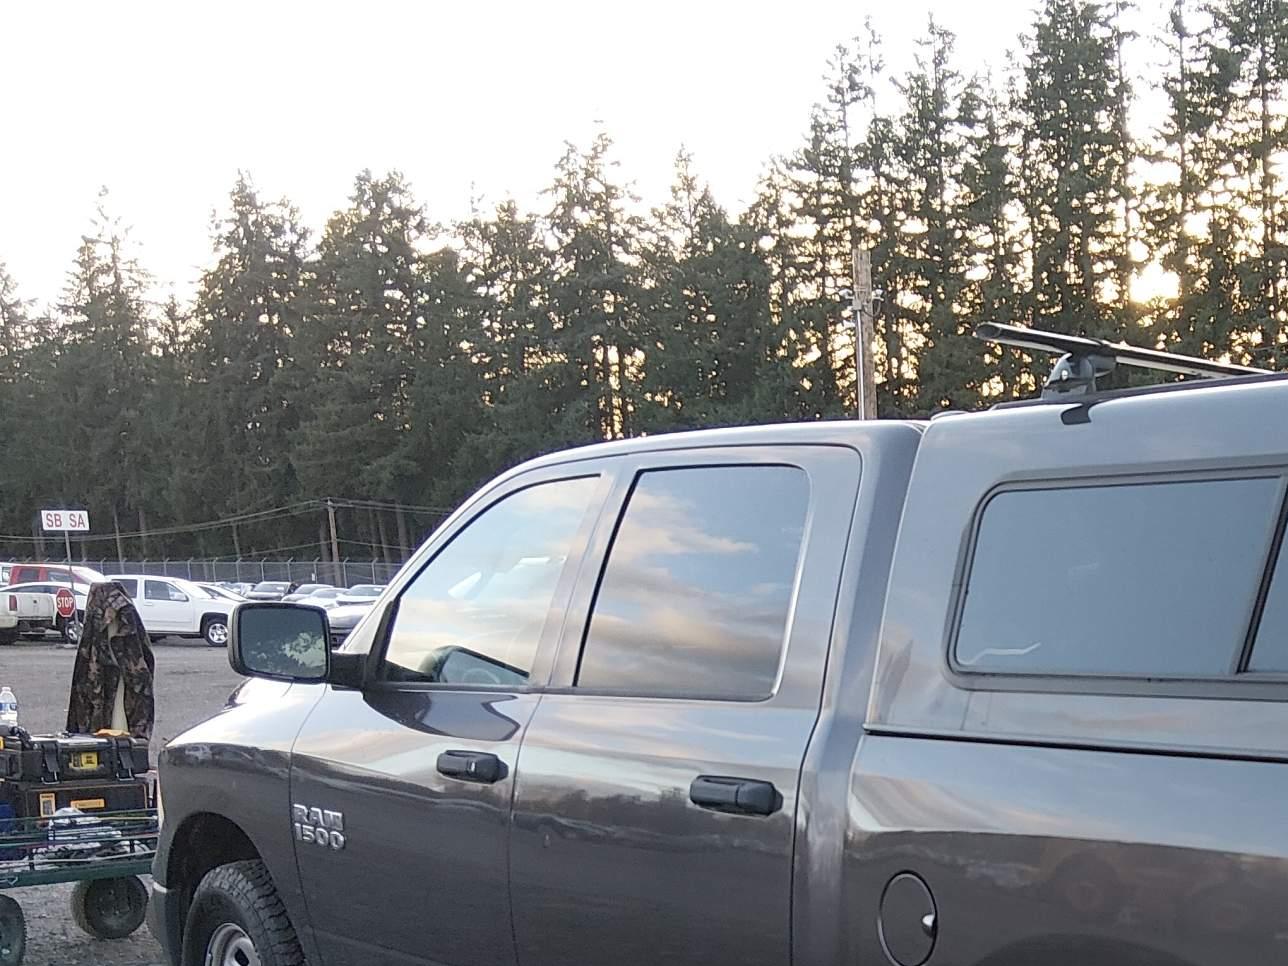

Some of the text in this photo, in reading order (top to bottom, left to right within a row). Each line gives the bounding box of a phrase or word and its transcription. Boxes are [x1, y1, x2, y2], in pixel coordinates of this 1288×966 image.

[46, 513, 85, 528] SB SA
[57, 597, 74, 608] STOP
[293, 803, 344, 831] RAM
[294, 822, 346, 850] 1500
